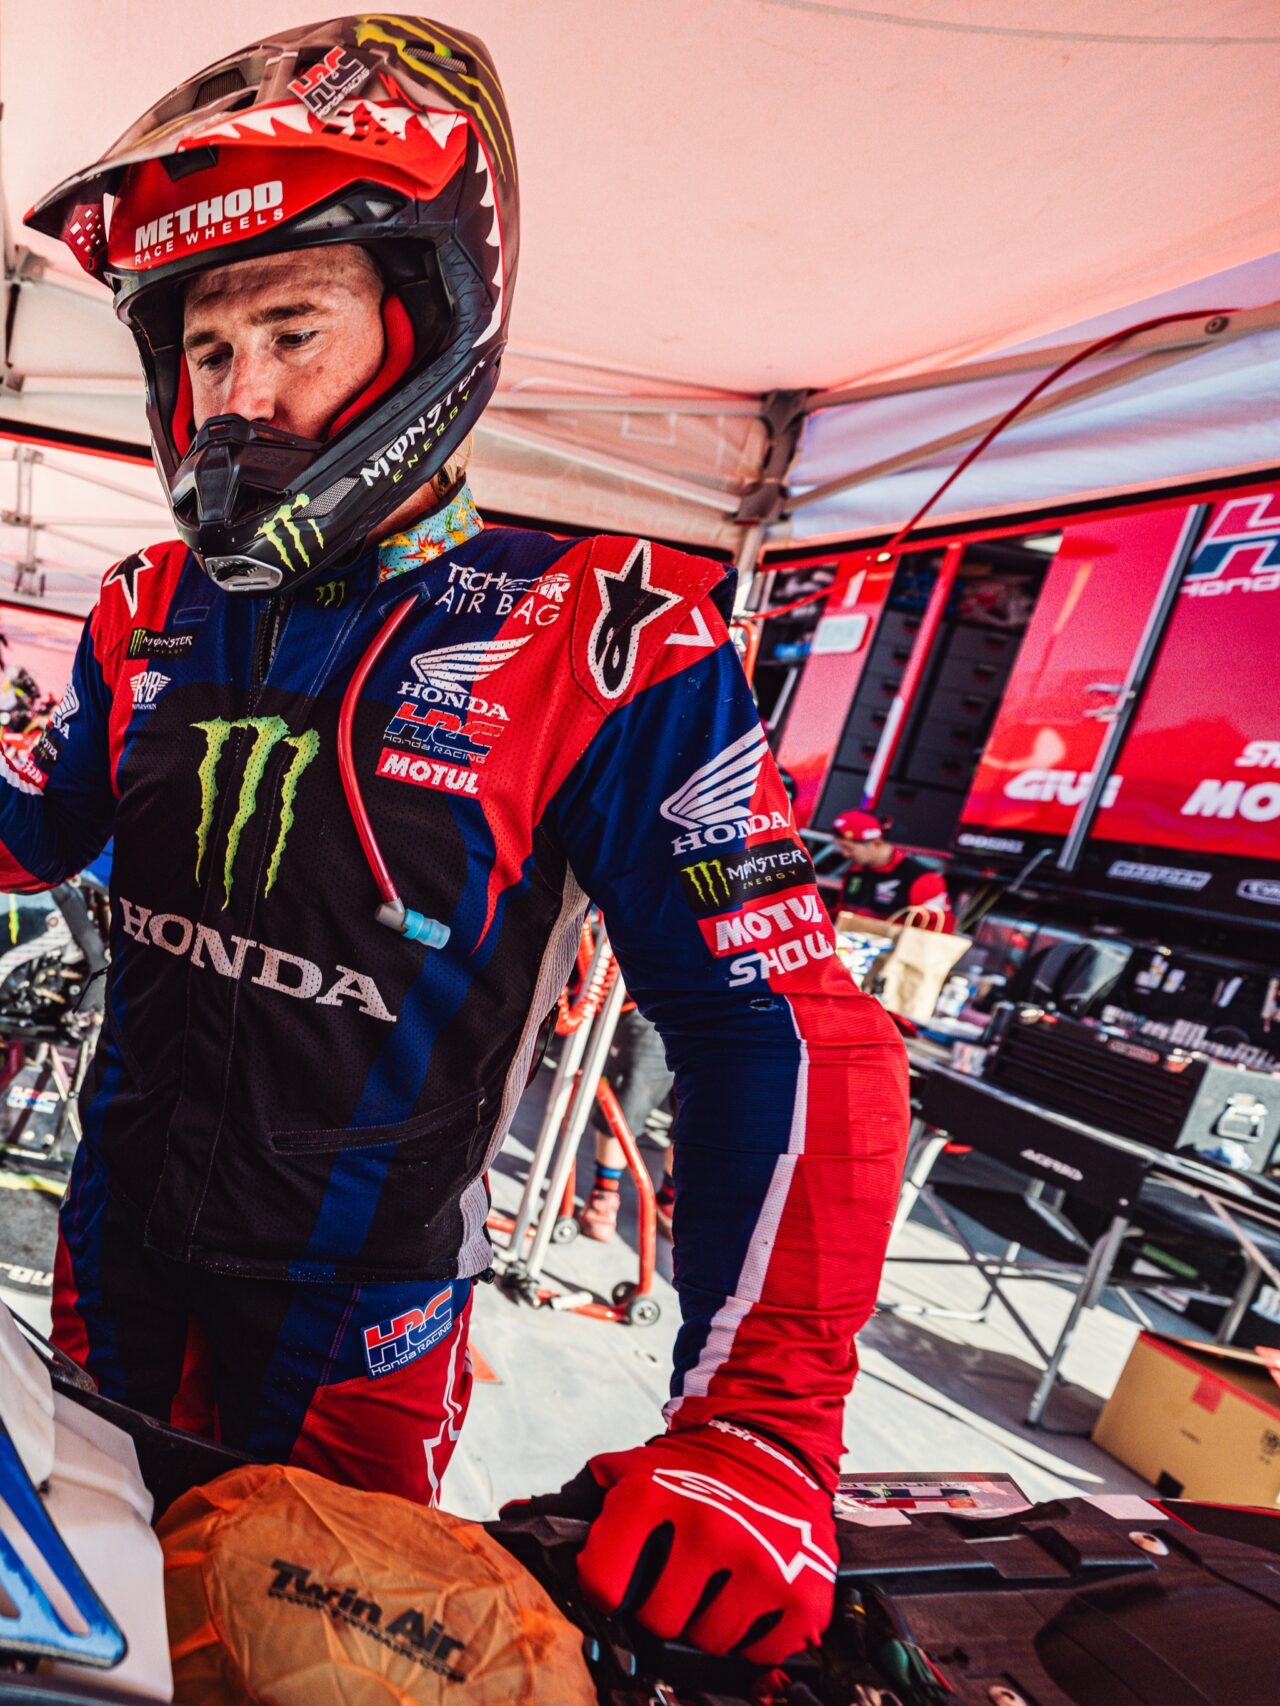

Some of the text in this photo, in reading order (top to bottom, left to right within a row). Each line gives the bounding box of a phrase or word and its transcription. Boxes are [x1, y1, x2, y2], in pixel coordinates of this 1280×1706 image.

[135, 180, 284, 253] METHOD
[135, 208, 284, 265] RACE WHEELS
[392, 389, 470, 483] ENERGY
[434, 585, 561, 626] AIR BAG
[384, 701, 505, 757] HRC
[397, 681, 511, 721] HONDA
[381, 753, 480, 794] MOTUL
[432, 745, 486, 764] RACING
[672, 811, 790, 856] HONDA
[726, 849, 807, 881] MONSTER
[743, 870, 797, 890] ENERGY
[716, 894, 823, 951] MOTUL
[121, 897, 397, 1023] HONDA
[364, 1286, 453, 1369] HRC
[371, 1321, 453, 1377] Honda RACING
[270, 1558, 466, 1661] Twin Air
